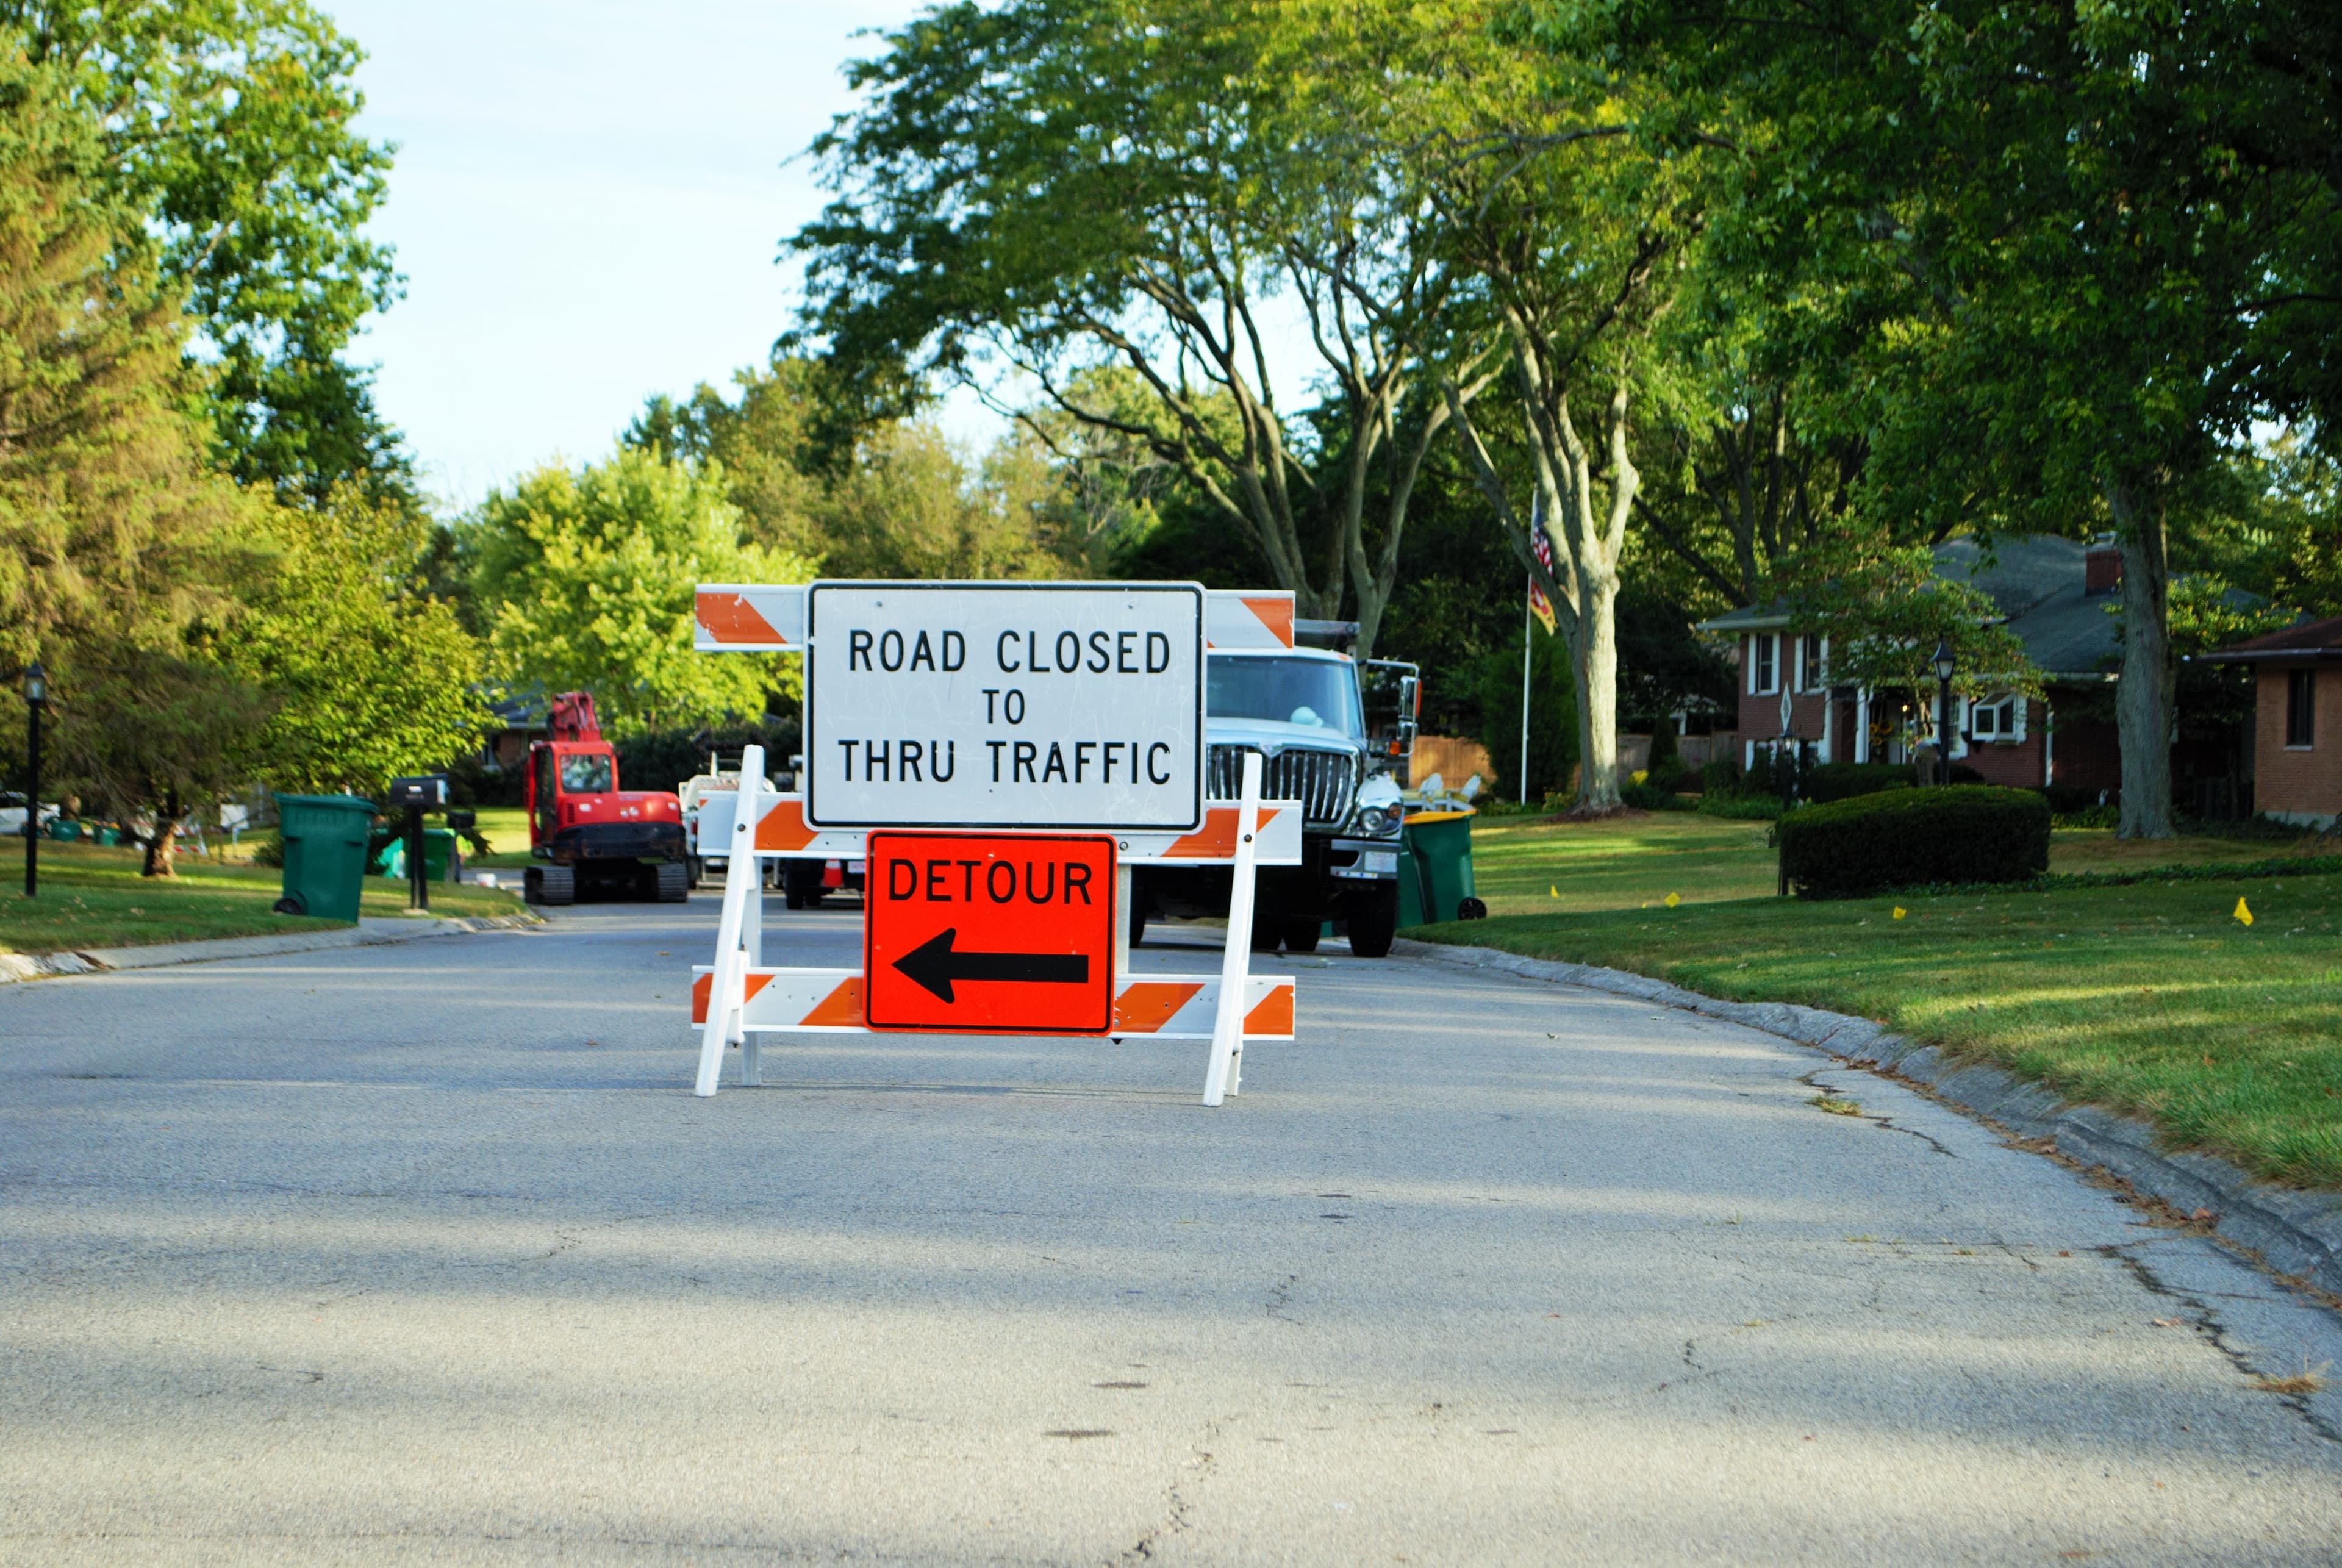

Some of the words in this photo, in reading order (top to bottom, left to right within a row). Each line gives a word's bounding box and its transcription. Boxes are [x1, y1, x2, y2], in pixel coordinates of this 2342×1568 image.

[850, 629, 966, 673] ROAD
[997, 630, 1170, 674] CLOSED
[981, 689, 1026, 726] TO
[837, 739, 955, 784] THRU
[985, 740, 1171, 786] TRAFFIC
[889, 857, 1092, 906] DETOUR
